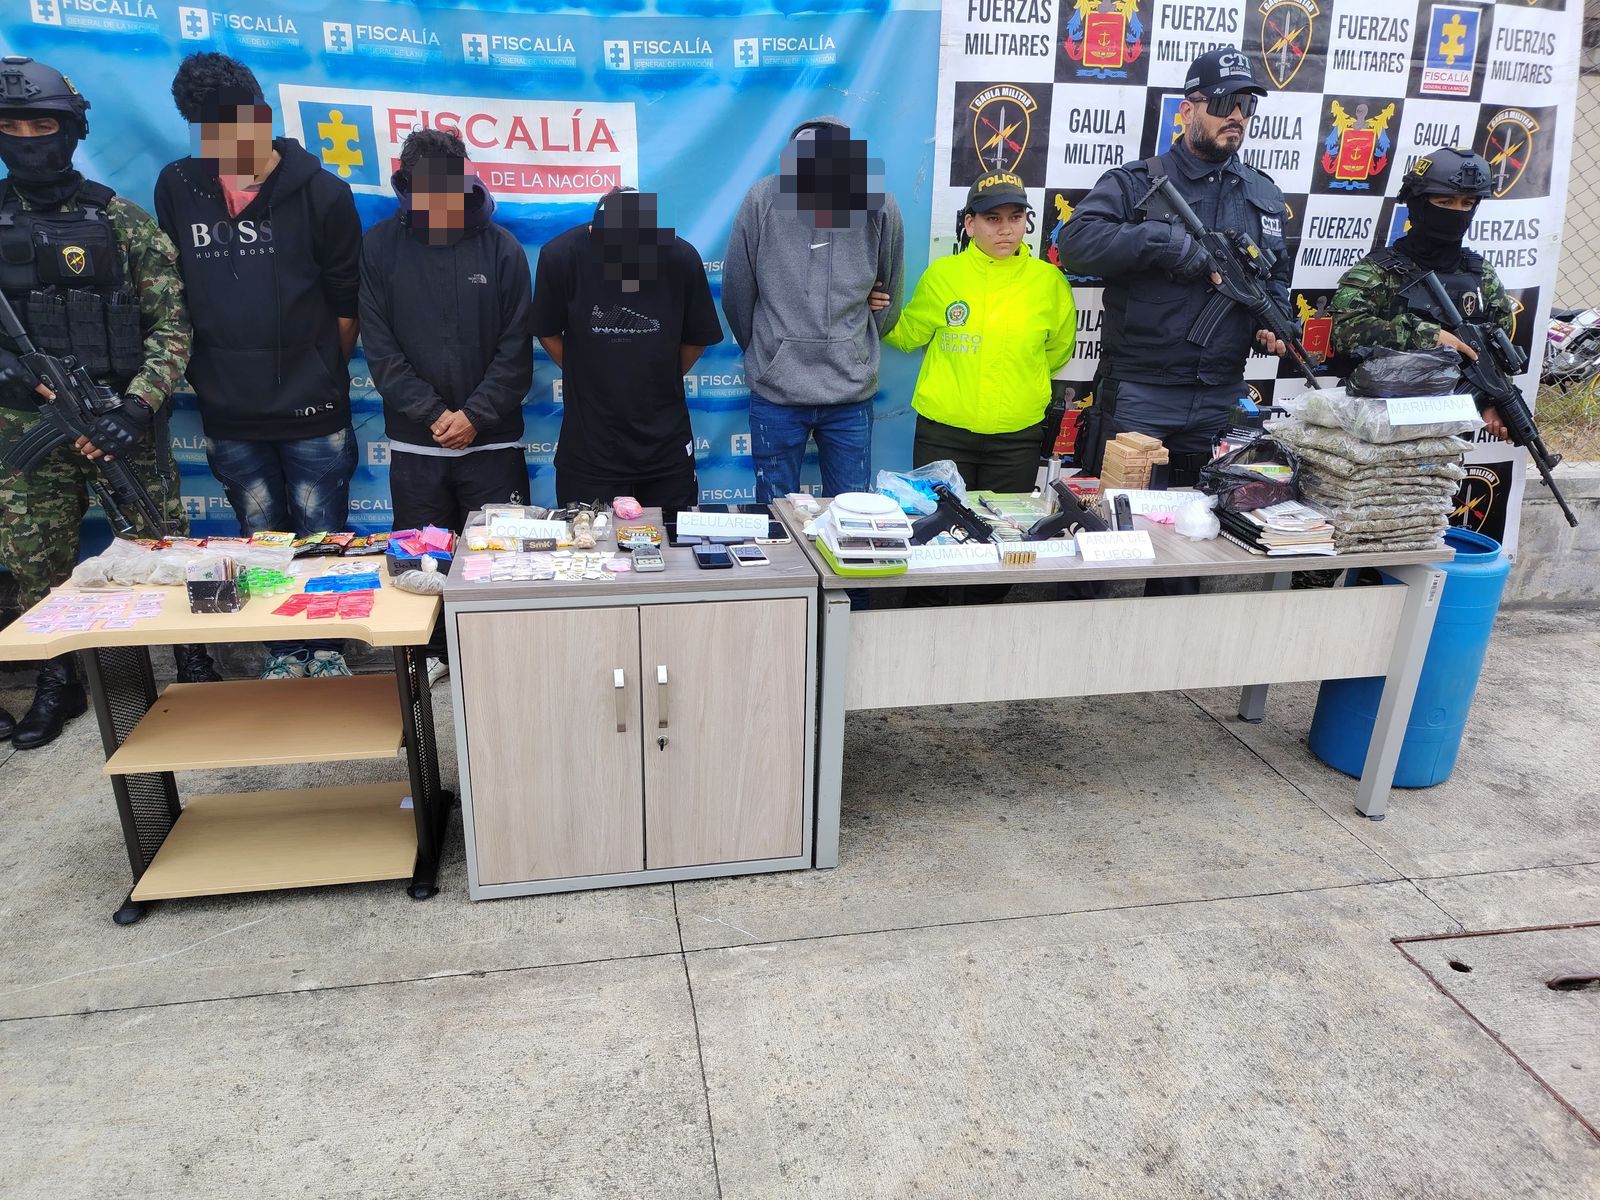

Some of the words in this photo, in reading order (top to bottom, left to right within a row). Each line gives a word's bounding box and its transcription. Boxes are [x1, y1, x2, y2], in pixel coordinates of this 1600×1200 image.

[211, 11, 298, 34] FISCALÍA
[968, 0, 1052, 24] FUERZAS
[1160, 4, 1239, 34] FUERZAS
[356, 24, 440, 46] FISCALÍA
[1337, 14, 1410, 43] FUERZAS
[491, 35, 575, 52] FISCALÍA
[633, 37, 713, 54] FISCALÍA
[762, 34, 836, 51] FISCALÍA
[964, 33, 1050, 57] MILITARES
[1495, 27, 1556, 56] FUERZAS
[1333, 49, 1405, 74] MILITARES
[1491, 60, 1553, 84] MILITARES
[1424, 71, 1470, 83] FISCALÍA
[975, 88, 1001, 108] GAULA
[1001, 88, 1031, 108] MILITAR
[387, 108, 620, 153] FISCALÍA
[1068, 108, 1126, 135] GAULA
[1248, 115, 1302, 140] GAULA
[1509, 111, 1534, 129] MILITAR
[1414, 122, 1460, 147] GAULA
[1064, 143, 1124, 166] MILITAR
[1244, 149, 1300, 170] MILITAR
[491, 171, 515, 187] DE
[521, 172, 544, 188] LA
[548, 170, 616, 188] NACIÓN
[977, 174, 1024, 193] POLICIA
[191, 220, 273, 248] BOSS
[1261, 215, 1281, 231] CTI
[1308, 216, 1372, 240] FUERZAS
[1467, 218, 1540, 242] UERZAS
[240, 247, 275, 257] BOSS
[1486, 248, 1538, 268] ITARES
[701, 485, 756, 500] FISCALÍ
[1130, 491, 1173, 501] TERIAS
[1175, 492, 1202, 502] PAR
[496, 525, 563, 539] COCAINA
[1086, 534, 1125, 546] ARMA
[1128, 533, 1147, 543] DE
